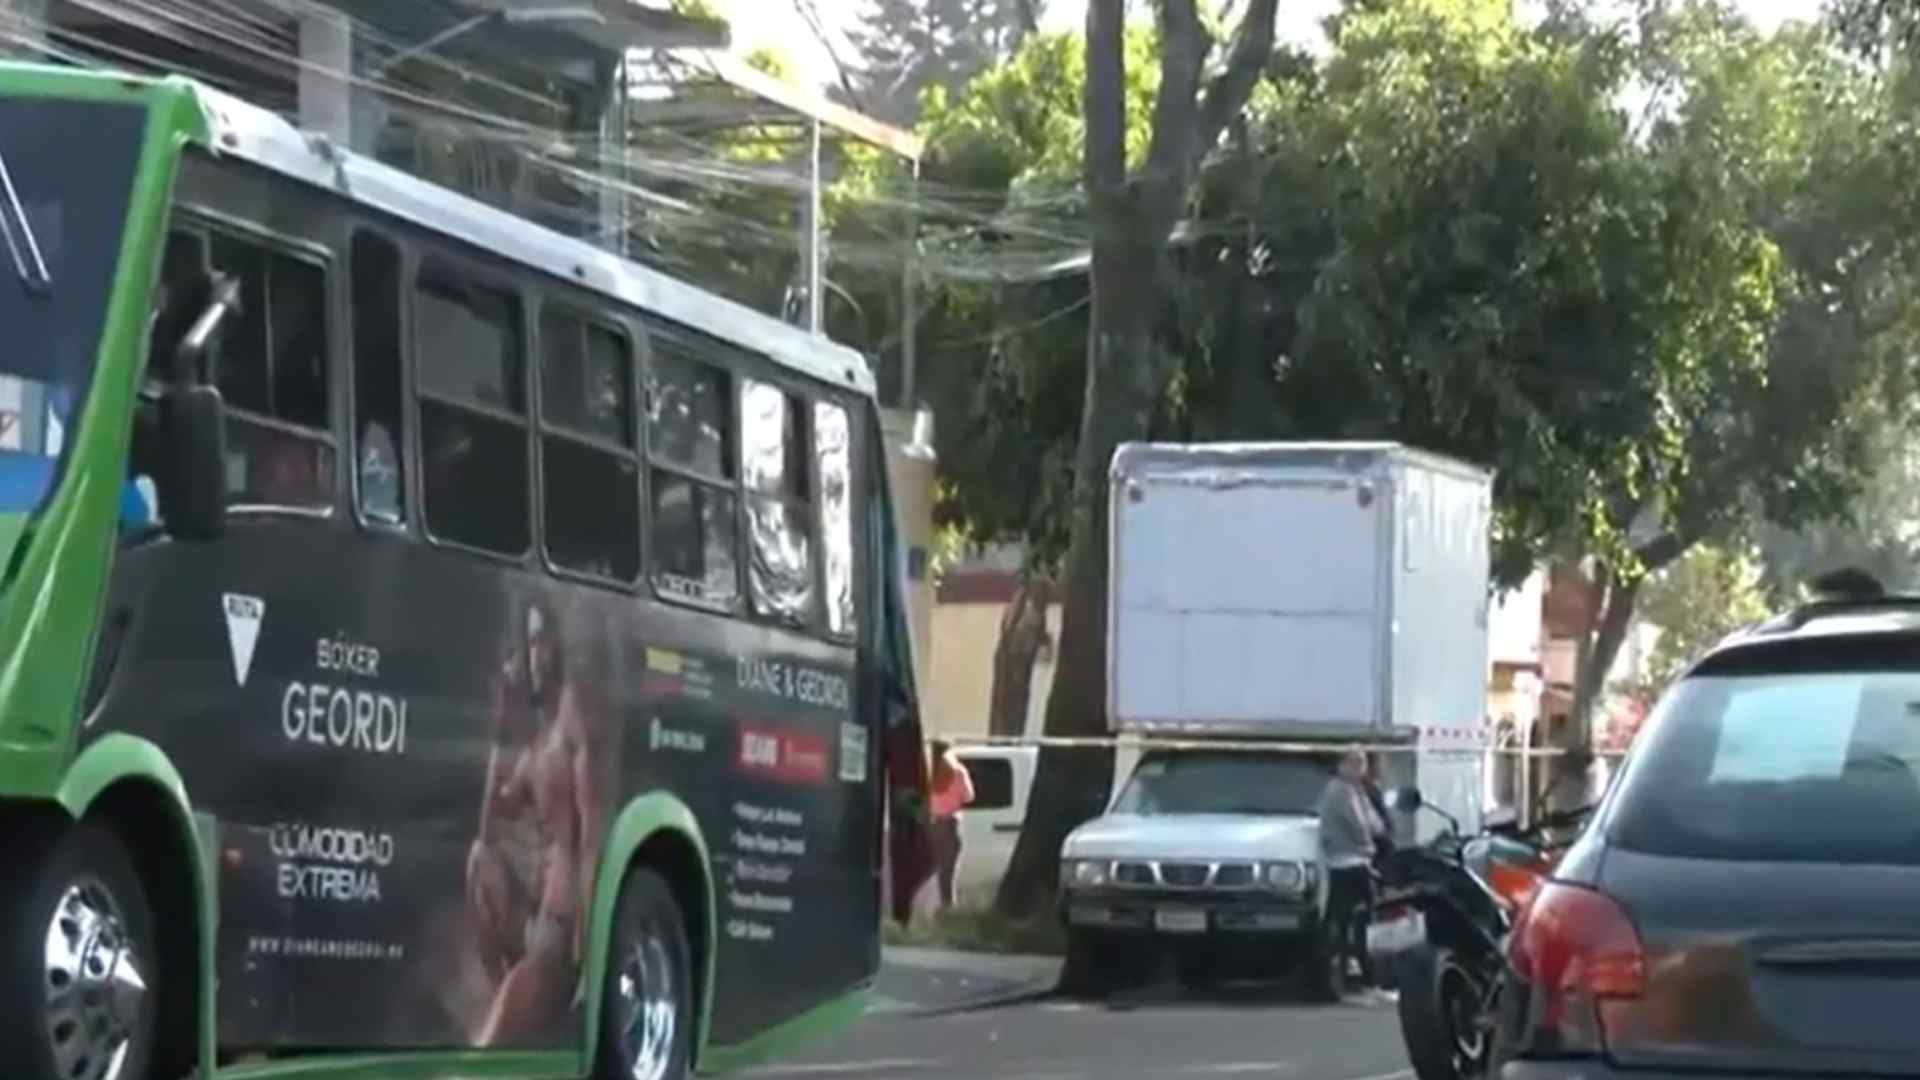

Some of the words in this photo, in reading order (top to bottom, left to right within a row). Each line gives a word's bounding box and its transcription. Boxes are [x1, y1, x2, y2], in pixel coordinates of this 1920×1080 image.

[281, 680, 408, 753] GEORDI
[269, 823, 395, 866] COMODIDAD
[277, 861, 383, 902] EXTREMA
